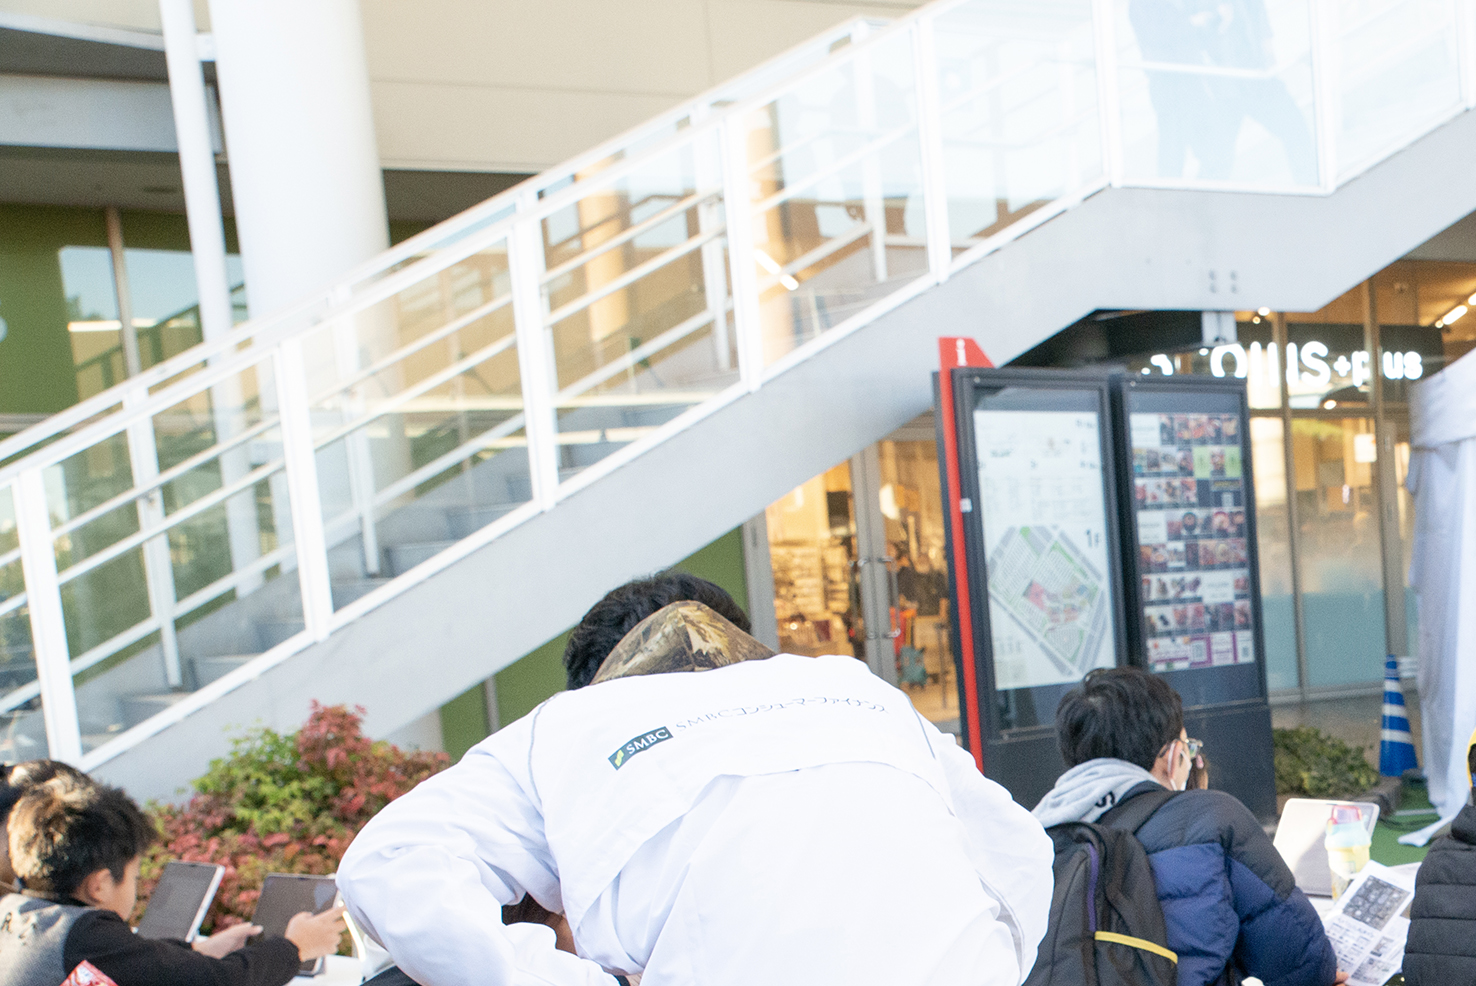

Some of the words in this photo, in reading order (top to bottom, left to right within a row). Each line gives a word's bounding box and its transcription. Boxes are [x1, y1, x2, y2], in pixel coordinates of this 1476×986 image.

[626, 729, 669, 755] SMBC
[676, 697, 889, 731] SMBCコンシューマーファイナンス
